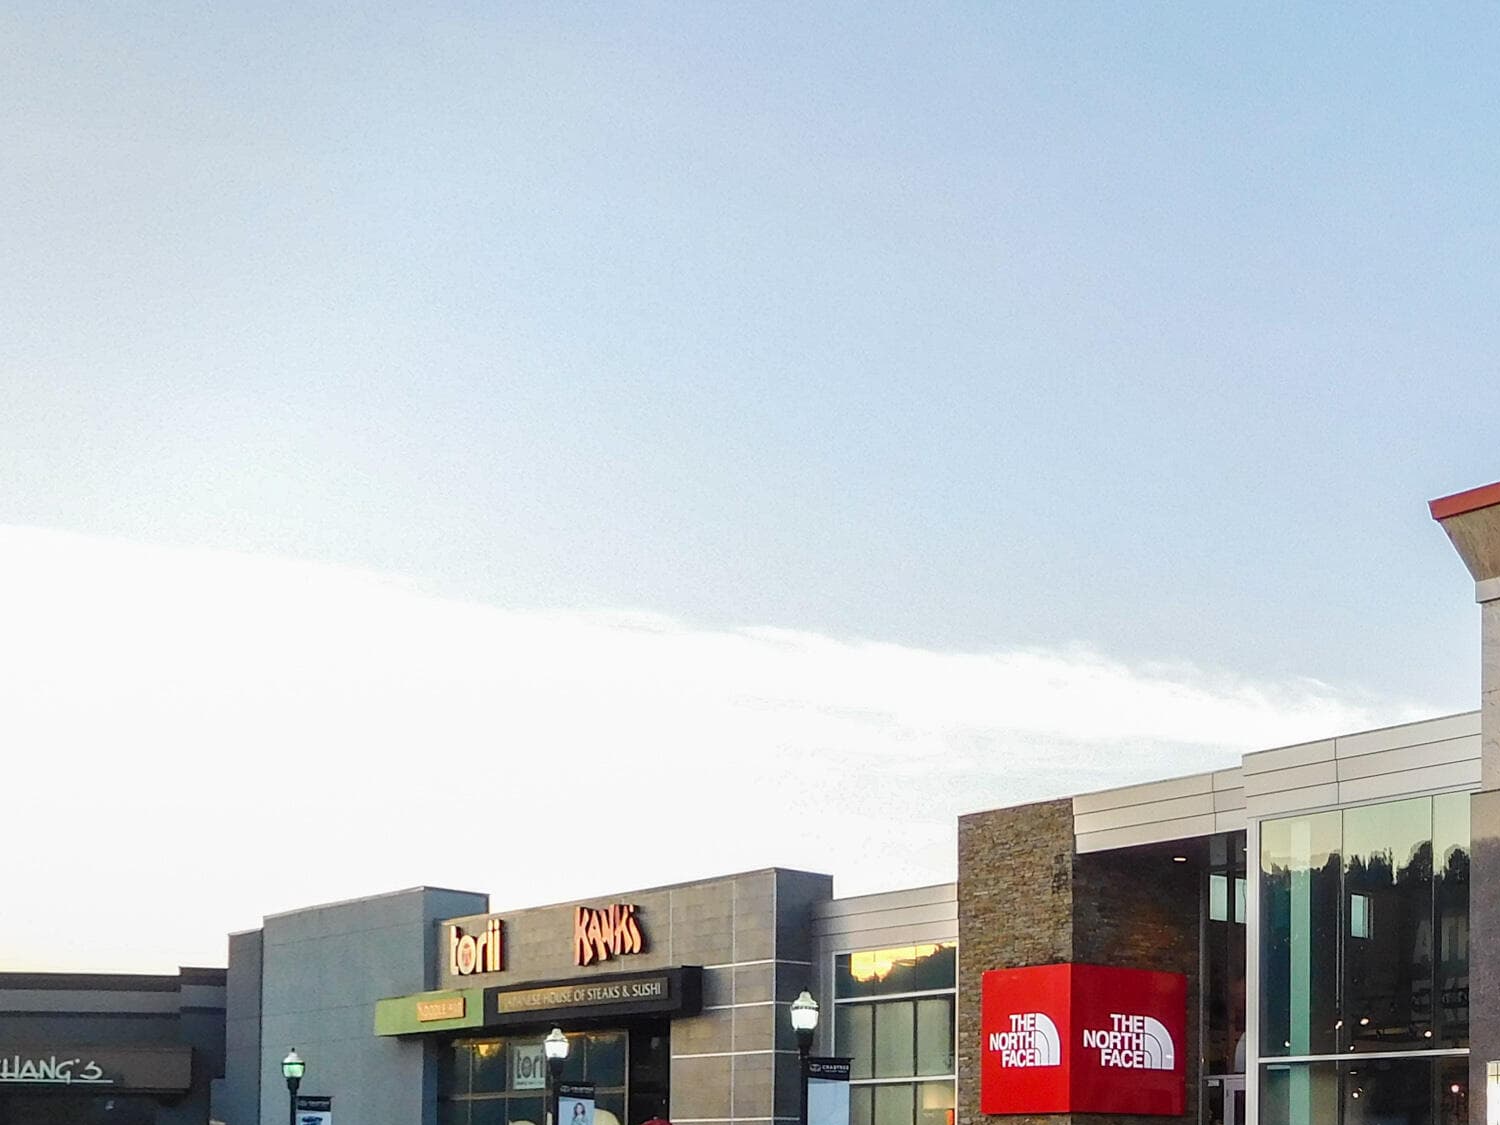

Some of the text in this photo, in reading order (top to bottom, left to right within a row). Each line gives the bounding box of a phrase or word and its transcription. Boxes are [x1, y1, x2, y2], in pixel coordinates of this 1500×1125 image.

[450, 918, 503, 976] torii
[543, 991, 573, 1003] HOUSE
[574, 989, 585, 1001] OF
[587, 985, 620, 1000] STEAKS
[622, 985, 630, 997] &
[632, 982, 661, 996] SUSHI
[1009, 1013, 1035, 1031] THE
[1110, 1014, 1144, 1032] THE
[989, 1031, 1035, 1051] NORTH
[1083, 1030, 1144, 1051] NORTH
[1002, 1050, 1035, 1067] FACE
[1101, 1050, 1144, 1068] FACE
[0, 1055, 103, 1084] HANG'S
